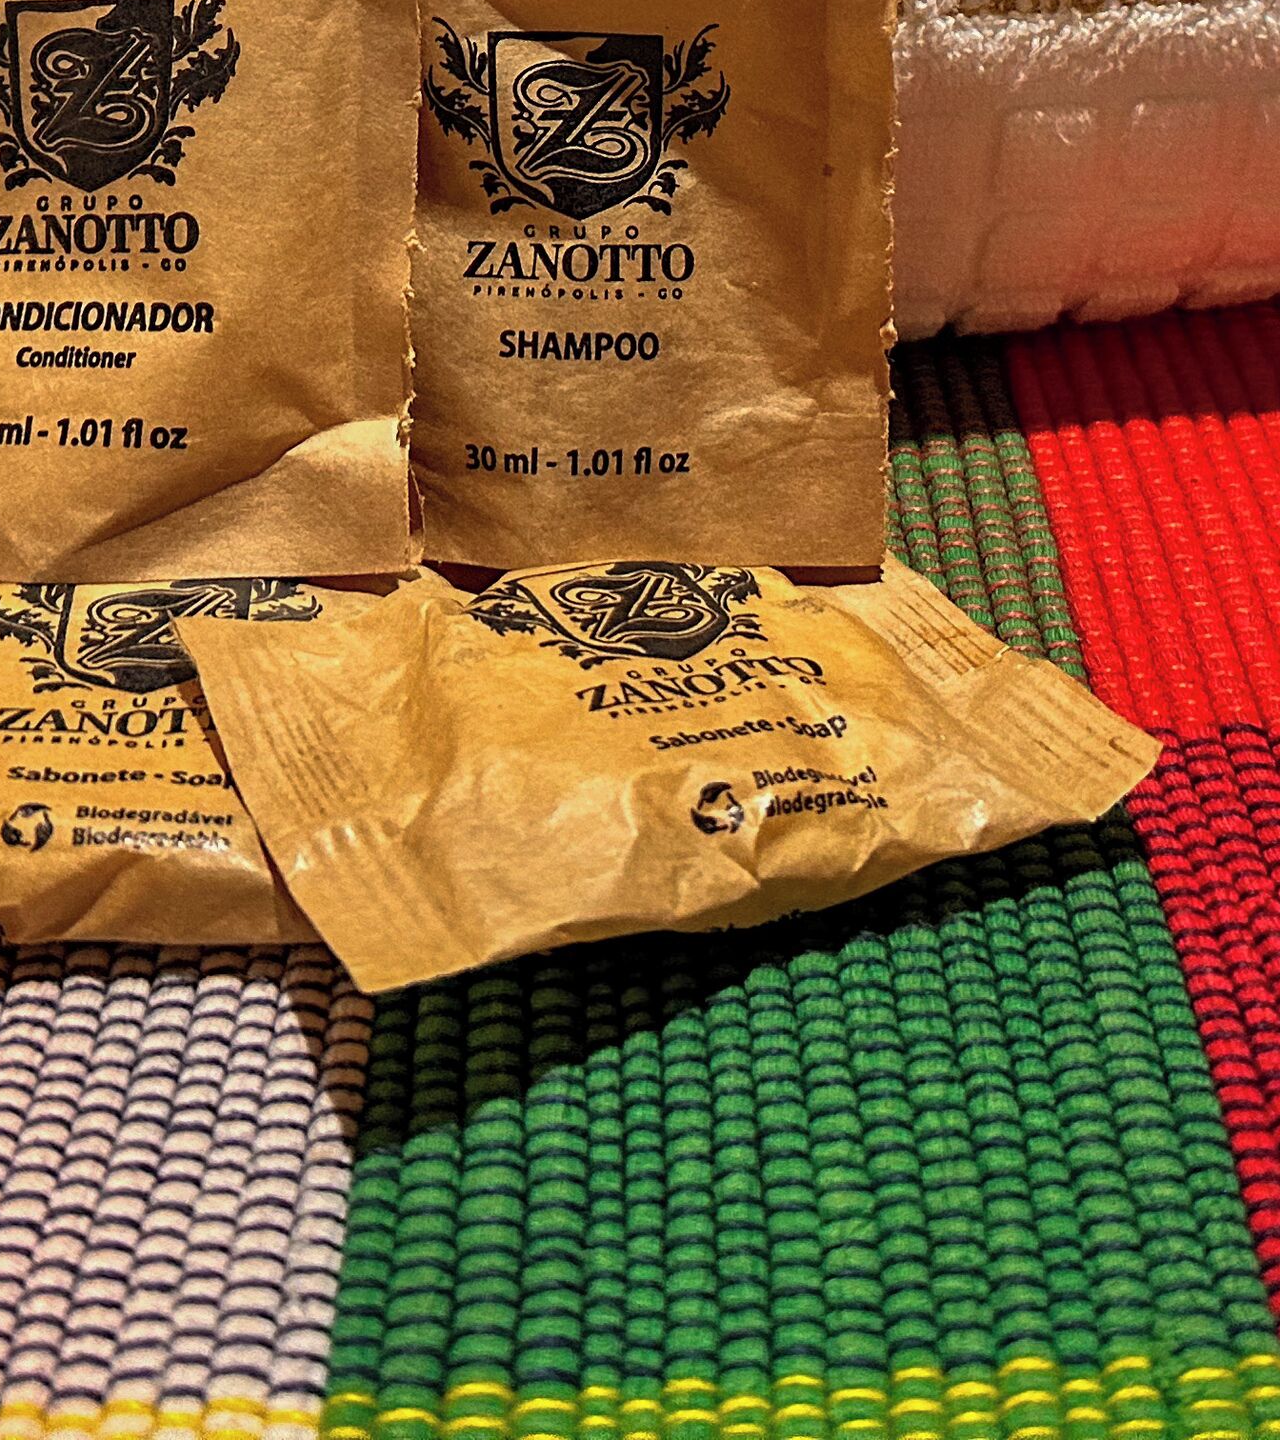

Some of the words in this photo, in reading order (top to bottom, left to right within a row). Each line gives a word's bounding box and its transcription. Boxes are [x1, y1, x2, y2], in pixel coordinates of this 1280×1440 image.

[35, 193, 144, 212] GRUPO
[523, 223, 640, 241] GRUPO
[462, 240, 696, 283] ZANOTTO
[472, 283, 625, 302] PIRENÓPOLIS
[657, 287, 684, 301] GO
[15, 345, 137, 369] Conditioner
[498, 329, 660, 361] SHAMPOO
[56, 417, 113, 448] 1.01
[121, 417, 144, 449] fl
[149, 426, 188, 450] oz
[464, 443, 497, 472] 30
[503, 446, 539, 475] ml
[566, 448, 625, 477] 1.01
[633, 446, 653, 475] fl
[658, 451, 691, 474] oz
[625, 647, 747, 680] GRUPO
[574, 654, 824, 712] ZANOTTO
[2, 734, 185, 749] PIRENÓPOLIS
[648, 717, 775, 751] Sabonete
[784, 713, 848, 739] Soap
[7, 765, 146, 784] Sabonete
[75, 804, 234, 827] Biodegradável
